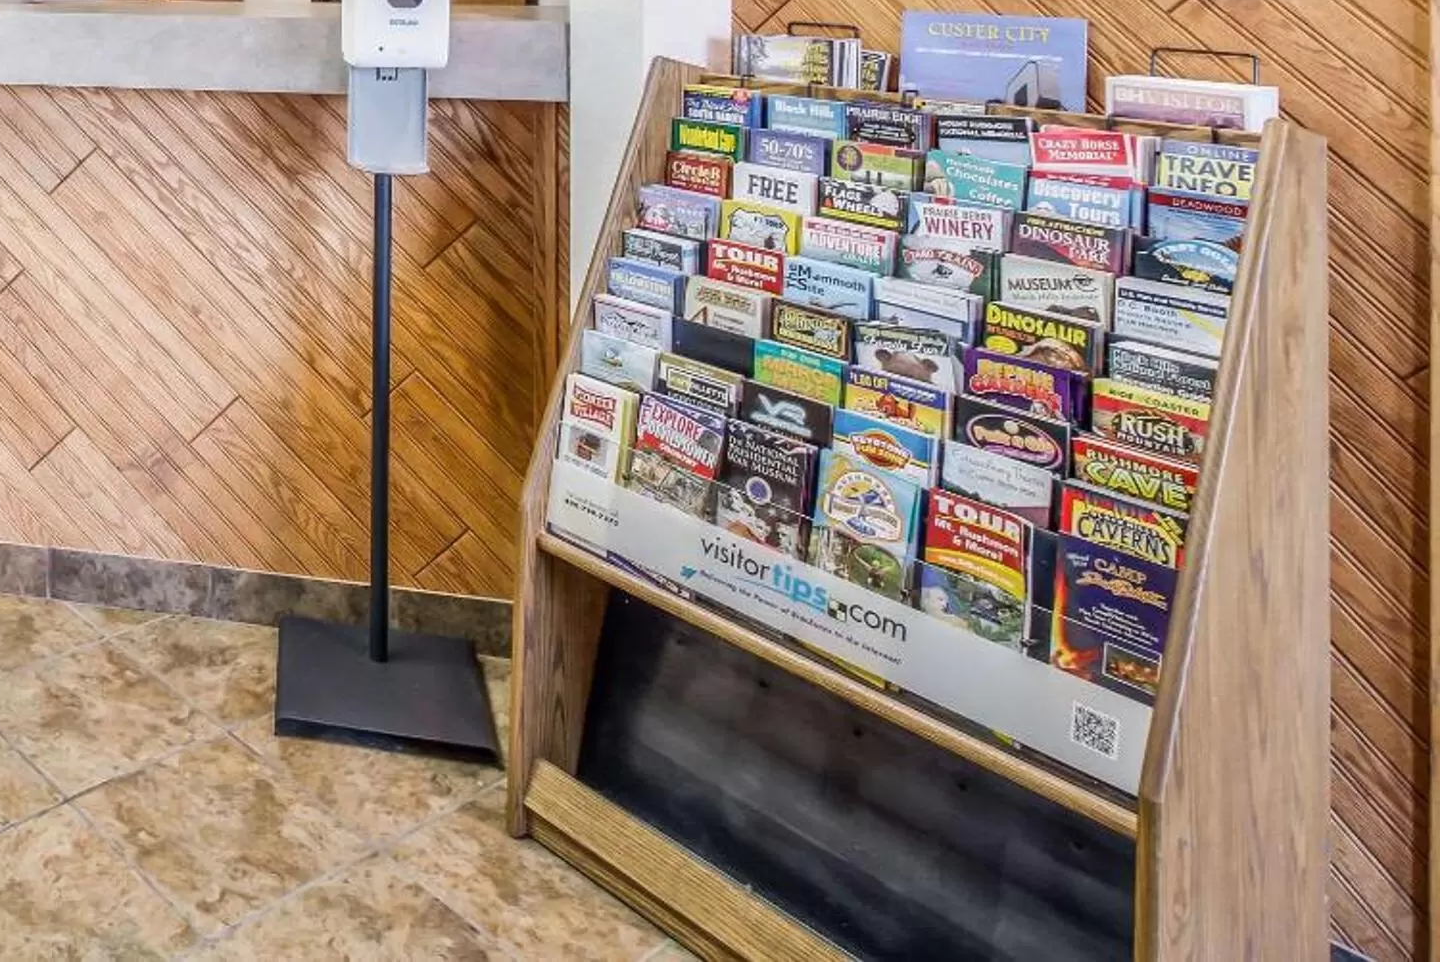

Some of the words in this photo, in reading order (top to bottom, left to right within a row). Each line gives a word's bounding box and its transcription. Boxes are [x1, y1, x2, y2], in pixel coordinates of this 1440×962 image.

[928, 21, 1000, 40] CUSTER
[1005, 26, 1051, 44] CITY
[1038, 138, 1079, 150] CRAZY
[1082, 140, 1120, 151] HORSE
[1186, 145, 1250, 161] ONLINE
[946, 166, 1019, 191] Chocolates
[1163, 155, 1252, 182] TRAVE
[747, 174, 799, 204] FREE
[824, 185, 861, 202] FLAGS
[1033, 178, 1122, 208] Discovery
[1167, 175, 1238, 197] INFO
[922, 206, 959, 218] PRAIRIE
[962, 210, 993, 222] BERRY
[1069, 202, 1120, 225] Tours
[1171, 197, 1243, 216] DEADWOOD
[924, 216, 994, 240] WINERY
[1018, 224, 1111, 252] DINOSAUR
[712, 243, 779, 269] TOUR
[1069, 246, 1110, 264] PARK
[798, 264, 866, 293] Mammoth
[798, 278, 825, 297] Site
[1008, 277, 1073, 292] MUSEUM
[986, 304, 1087, 347] DINOSAUR
[652, 403, 702, 442] EXPLORE
[1120, 413, 1187, 447] RUSH
[1117, 432, 1187, 456] MOUNTAIN
[1086, 449, 1185, 485] RUSHMORE
[1085, 461, 1188, 509] CAVE
[933, 495, 1021, 543] TOUR
[1077, 513, 1171, 565] CAVERNS
[1094, 558, 1147, 583] CAMP
